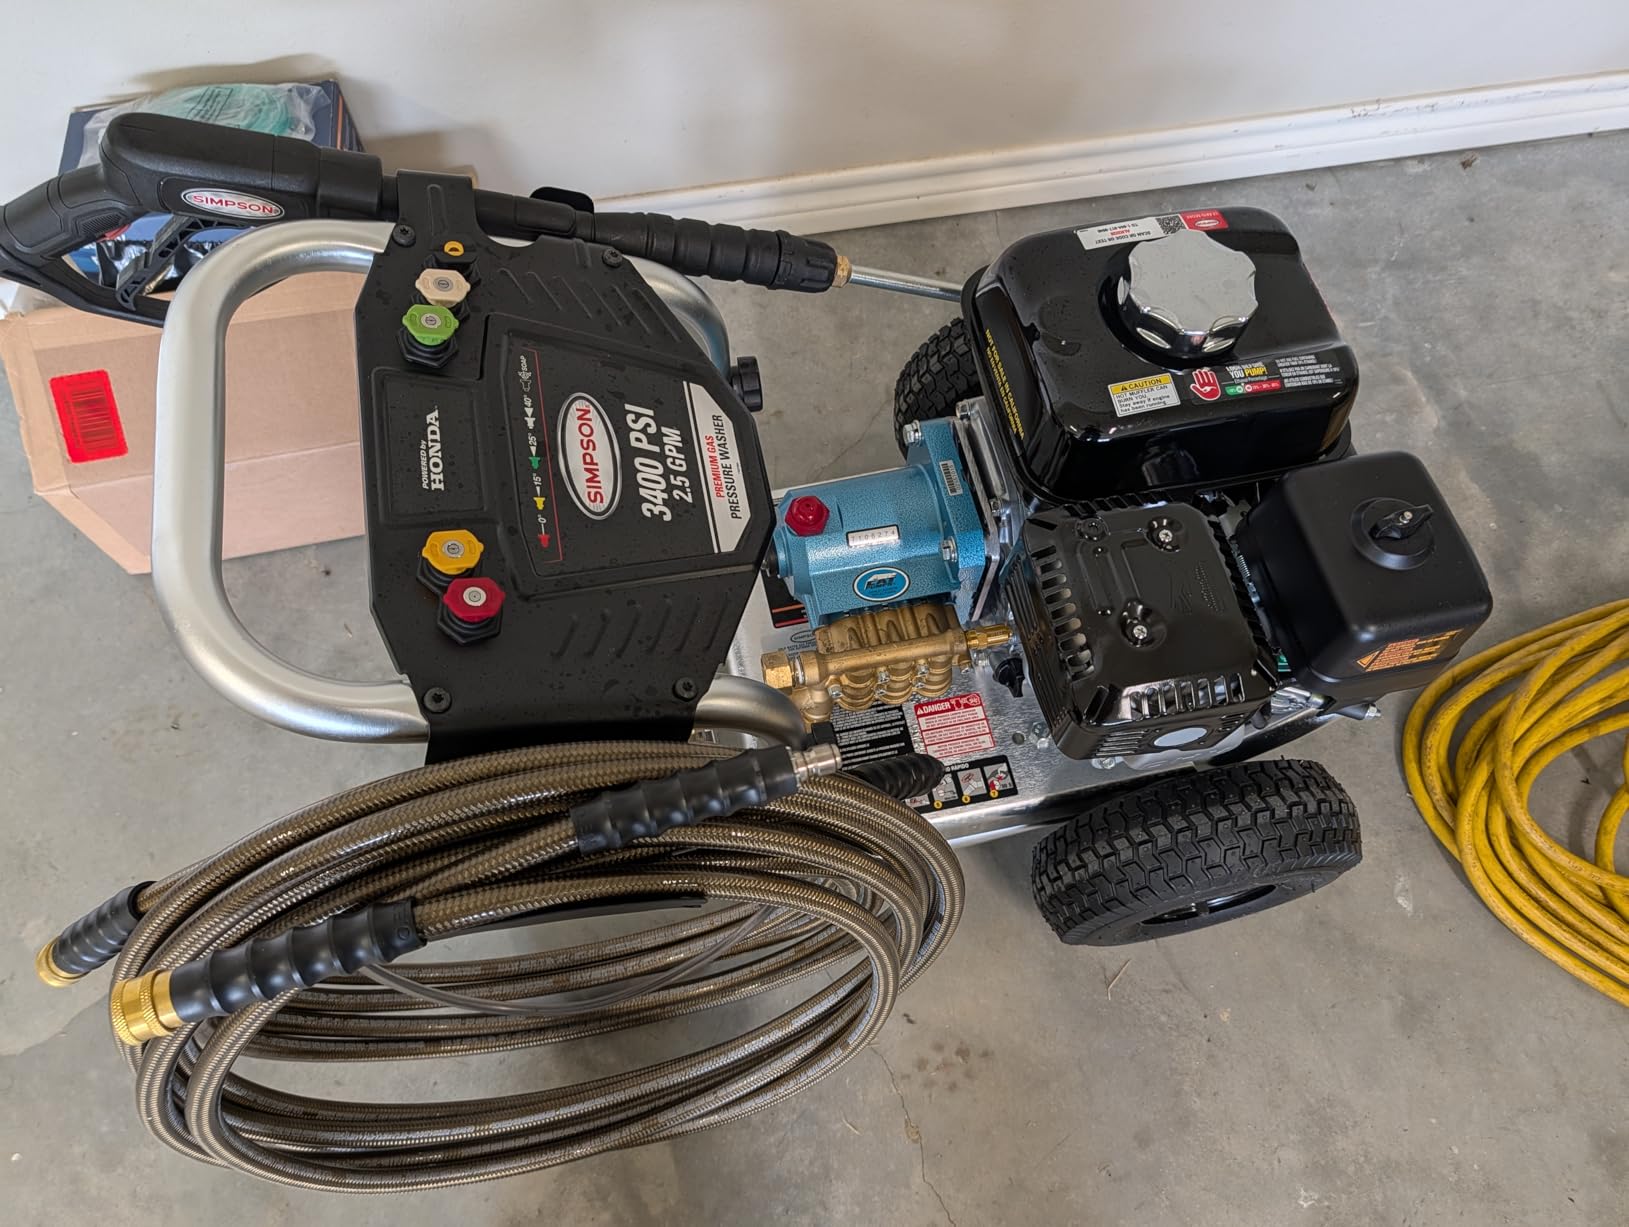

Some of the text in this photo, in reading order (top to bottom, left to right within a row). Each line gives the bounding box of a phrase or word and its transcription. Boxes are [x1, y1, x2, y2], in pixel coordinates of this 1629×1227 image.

[192, 195, 274, 214] SIMPSON
[520, 355, 528, 371] SOAP
[986, 329, 994, 346] NOT
[992, 345, 1000, 363] FOR
[998, 361, 1007, 383] SALE
[1007, 392, 1024, 440] CALIFORNIA
[1128, 378, 1162, 390] CAUTION
[1230, 368, 1244, 378] YOU
[1244, 366, 1267, 377] PUMP!
[523, 395, 532, 407] 40°
[1129, 388, 1154, 396] MUFFLER
[426, 409, 444, 491] HONDA
[527, 433, 537, 446] 25°
[575, 407, 604, 505] SIMPSON
[717, 414, 732, 460] WASHER
[420, 439, 430, 489] POWERED by
[624, 403, 672, 522] 3400 PSI
[661, 426, 693, 503] 2.5 GPM
[704, 435, 725, 498] PREMIUM GAS
[724, 462, 742, 520] PRESSURE
[923, 701, 951, 713] DANGER
